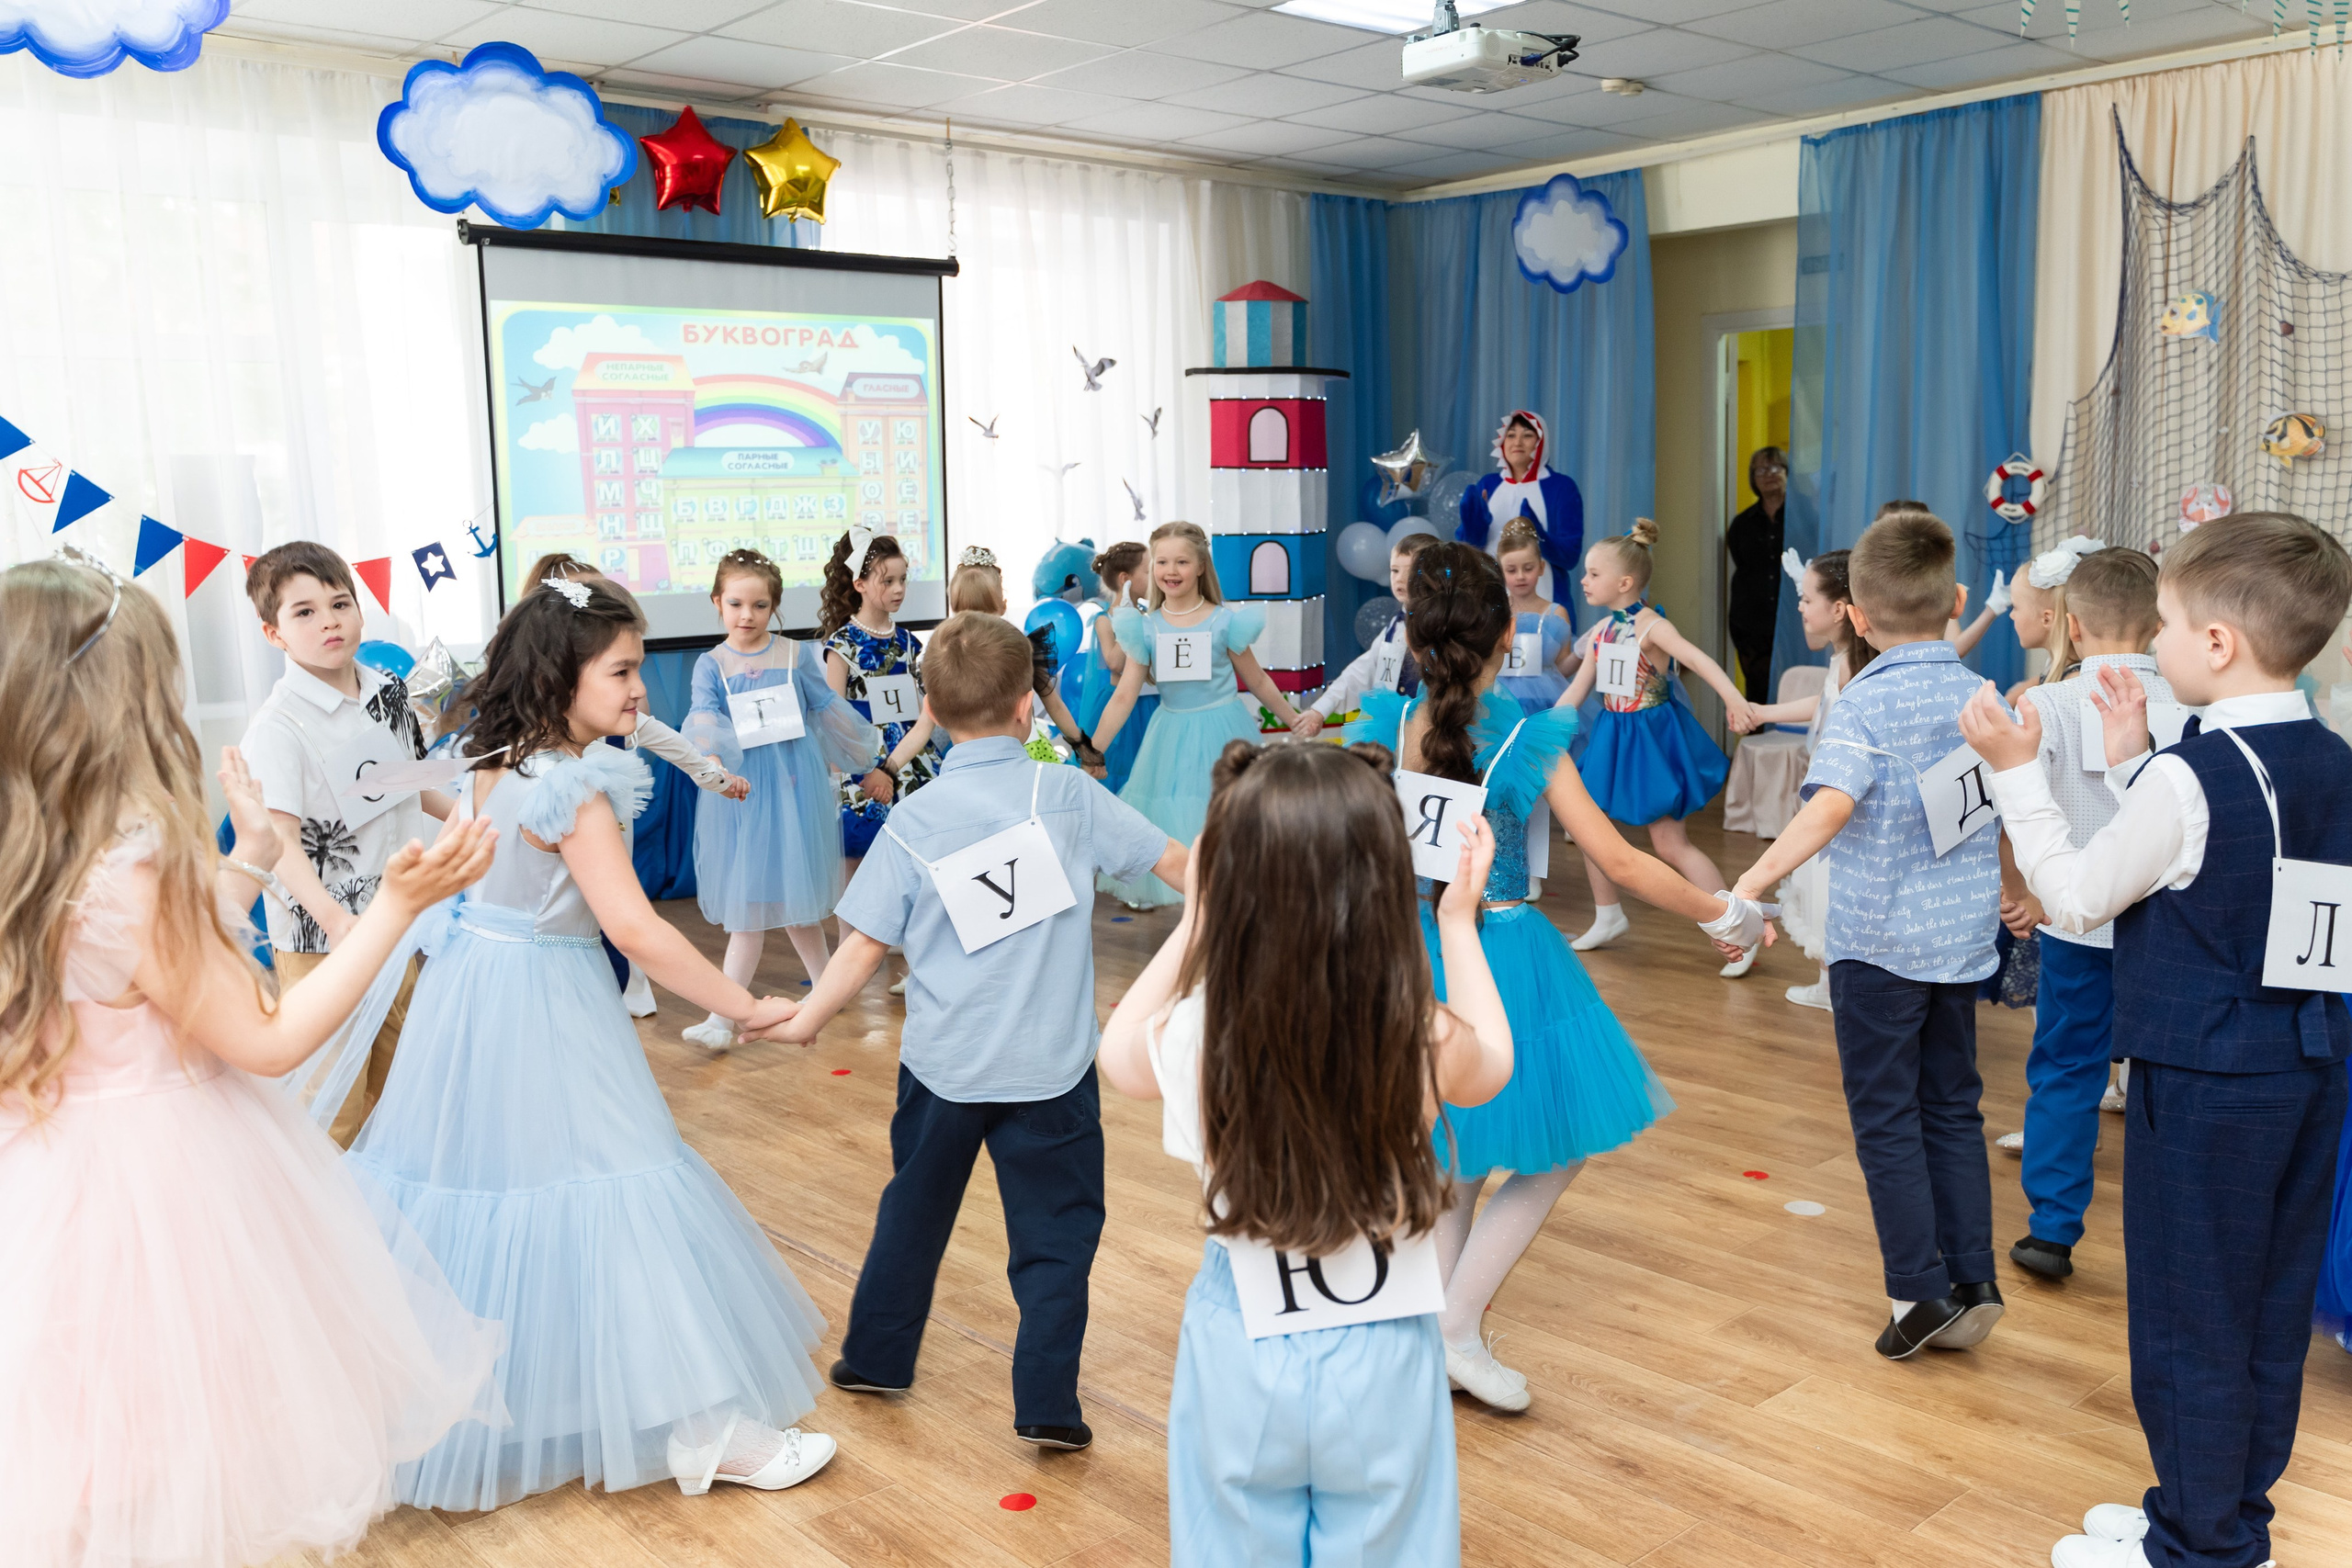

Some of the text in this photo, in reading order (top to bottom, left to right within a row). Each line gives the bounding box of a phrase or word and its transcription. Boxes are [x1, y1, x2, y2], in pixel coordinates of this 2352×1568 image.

[683, 323, 858, 348] БУКВОГРАД
[603, 372, 670, 381] СОГЛАСНЫЕ
[607, 363, 664, 372] НЕПАРНЫЕ
[864, 384, 910, 392] ГЛАСНЫЕ
[597, 412, 655, 434] Й Х
[864, 423, 915, 439] У Ю
[599, 450, 658, 470] Л Ц
[862, 452, 914, 468] Ы И
[600, 481, 658, 501] М Ч
[865, 477, 914, 500] О Ё
[677, 495, 840, 516] Б В Г Д Ж З
[602, 513, 665, 536] Н Щ
[902, 513, 915, 528] Е
[606, 549, 620, 567] Р
[1172, 637, 1193, 669] Ё
[1509, 647, 1526, 669] В
[1380, 657, 1396, 682] Ж
[1609, 659, 1625, 686] П
[881, 689, 903, 714] Ч
[1954, 761, 1994, 834] Д
[1408, 794, 1453, 848] Я
[971, 857, 1019, 919] У
[2296, 900, 2342, 967] Л
